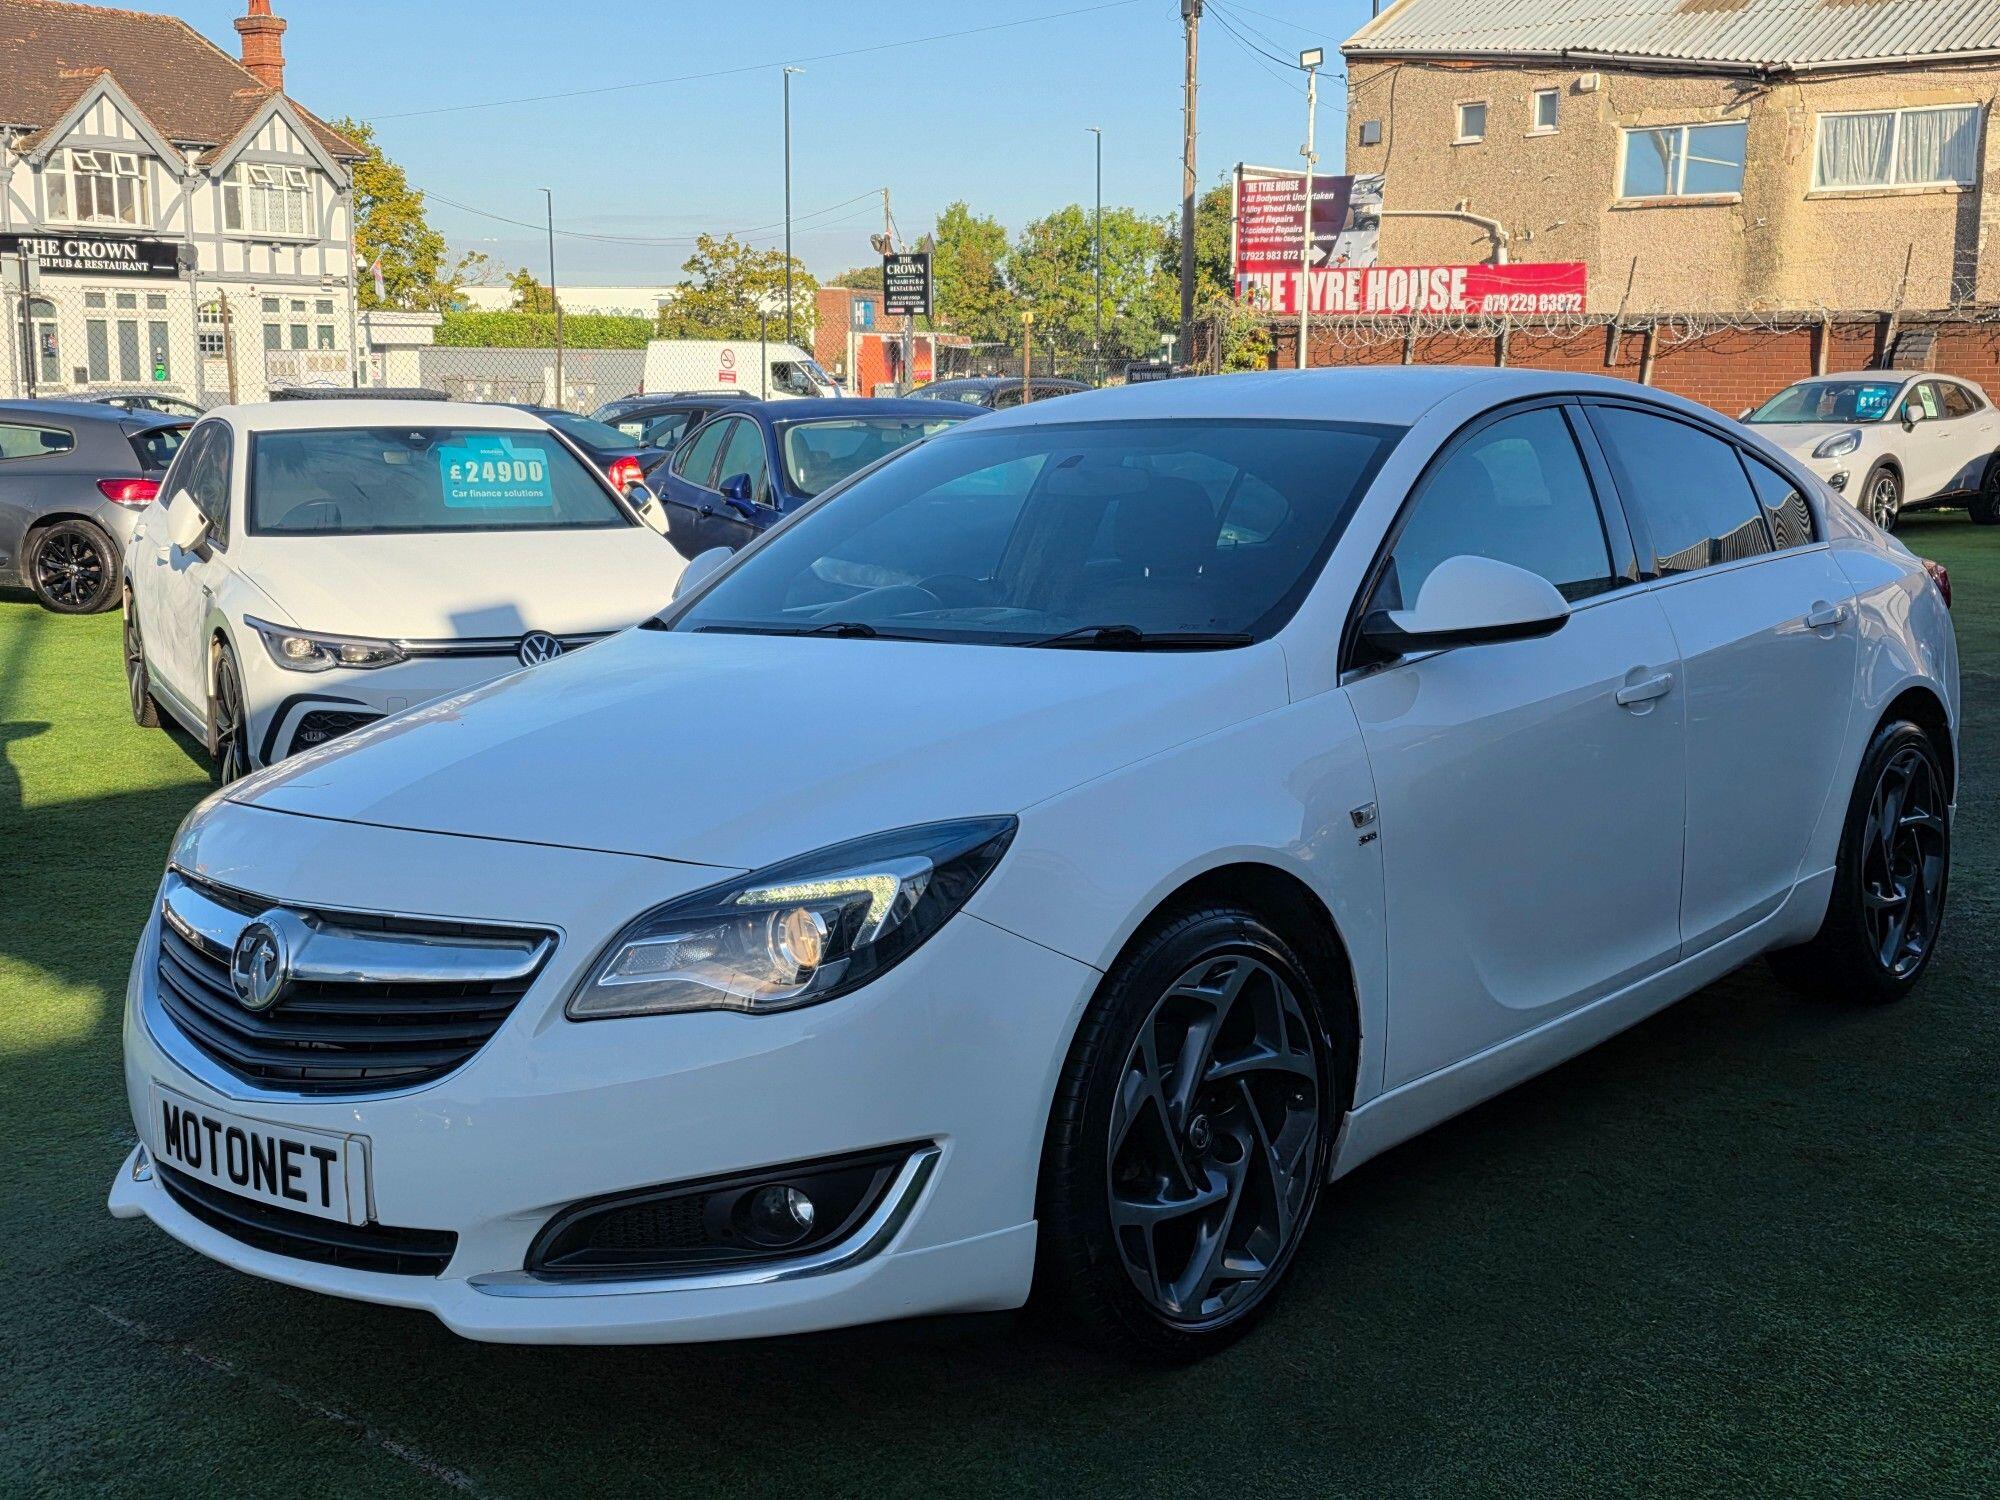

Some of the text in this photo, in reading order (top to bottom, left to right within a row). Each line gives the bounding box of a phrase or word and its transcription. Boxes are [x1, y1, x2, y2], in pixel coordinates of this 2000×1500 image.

[1245, 180, 1299, 193] THE TYRE HOUSE
[1246, 192, 1334, 204] All Bodywork Undrtaken
[1246, 206, 1262, 214] Alloy
[1263, 205, 1285, 213] Wheel
[1266, 215, 1294, 224] Repairs
[1245, 225, 1303, 234] Accident Repairs
[18, 238, 137, 259] THE CROWN
[898, 256, 912, 264] THE
[1241, 250, 1298, 260] 07922 983 872
[53, 258, 71, 268] PUB
[75, 259, 82, 269] &
[85, 259, 148, 271] RESTAURANT
[886, 264, 924, 274] CROWN
[1237, 268, 1468, 311] THE TYRE HOUSE
[1483, 294, 1581, 311] 079 229 83872
[452, 489, 544, 498] Car finance solutions
[163, 1100, 337, 1208] MOTONET
